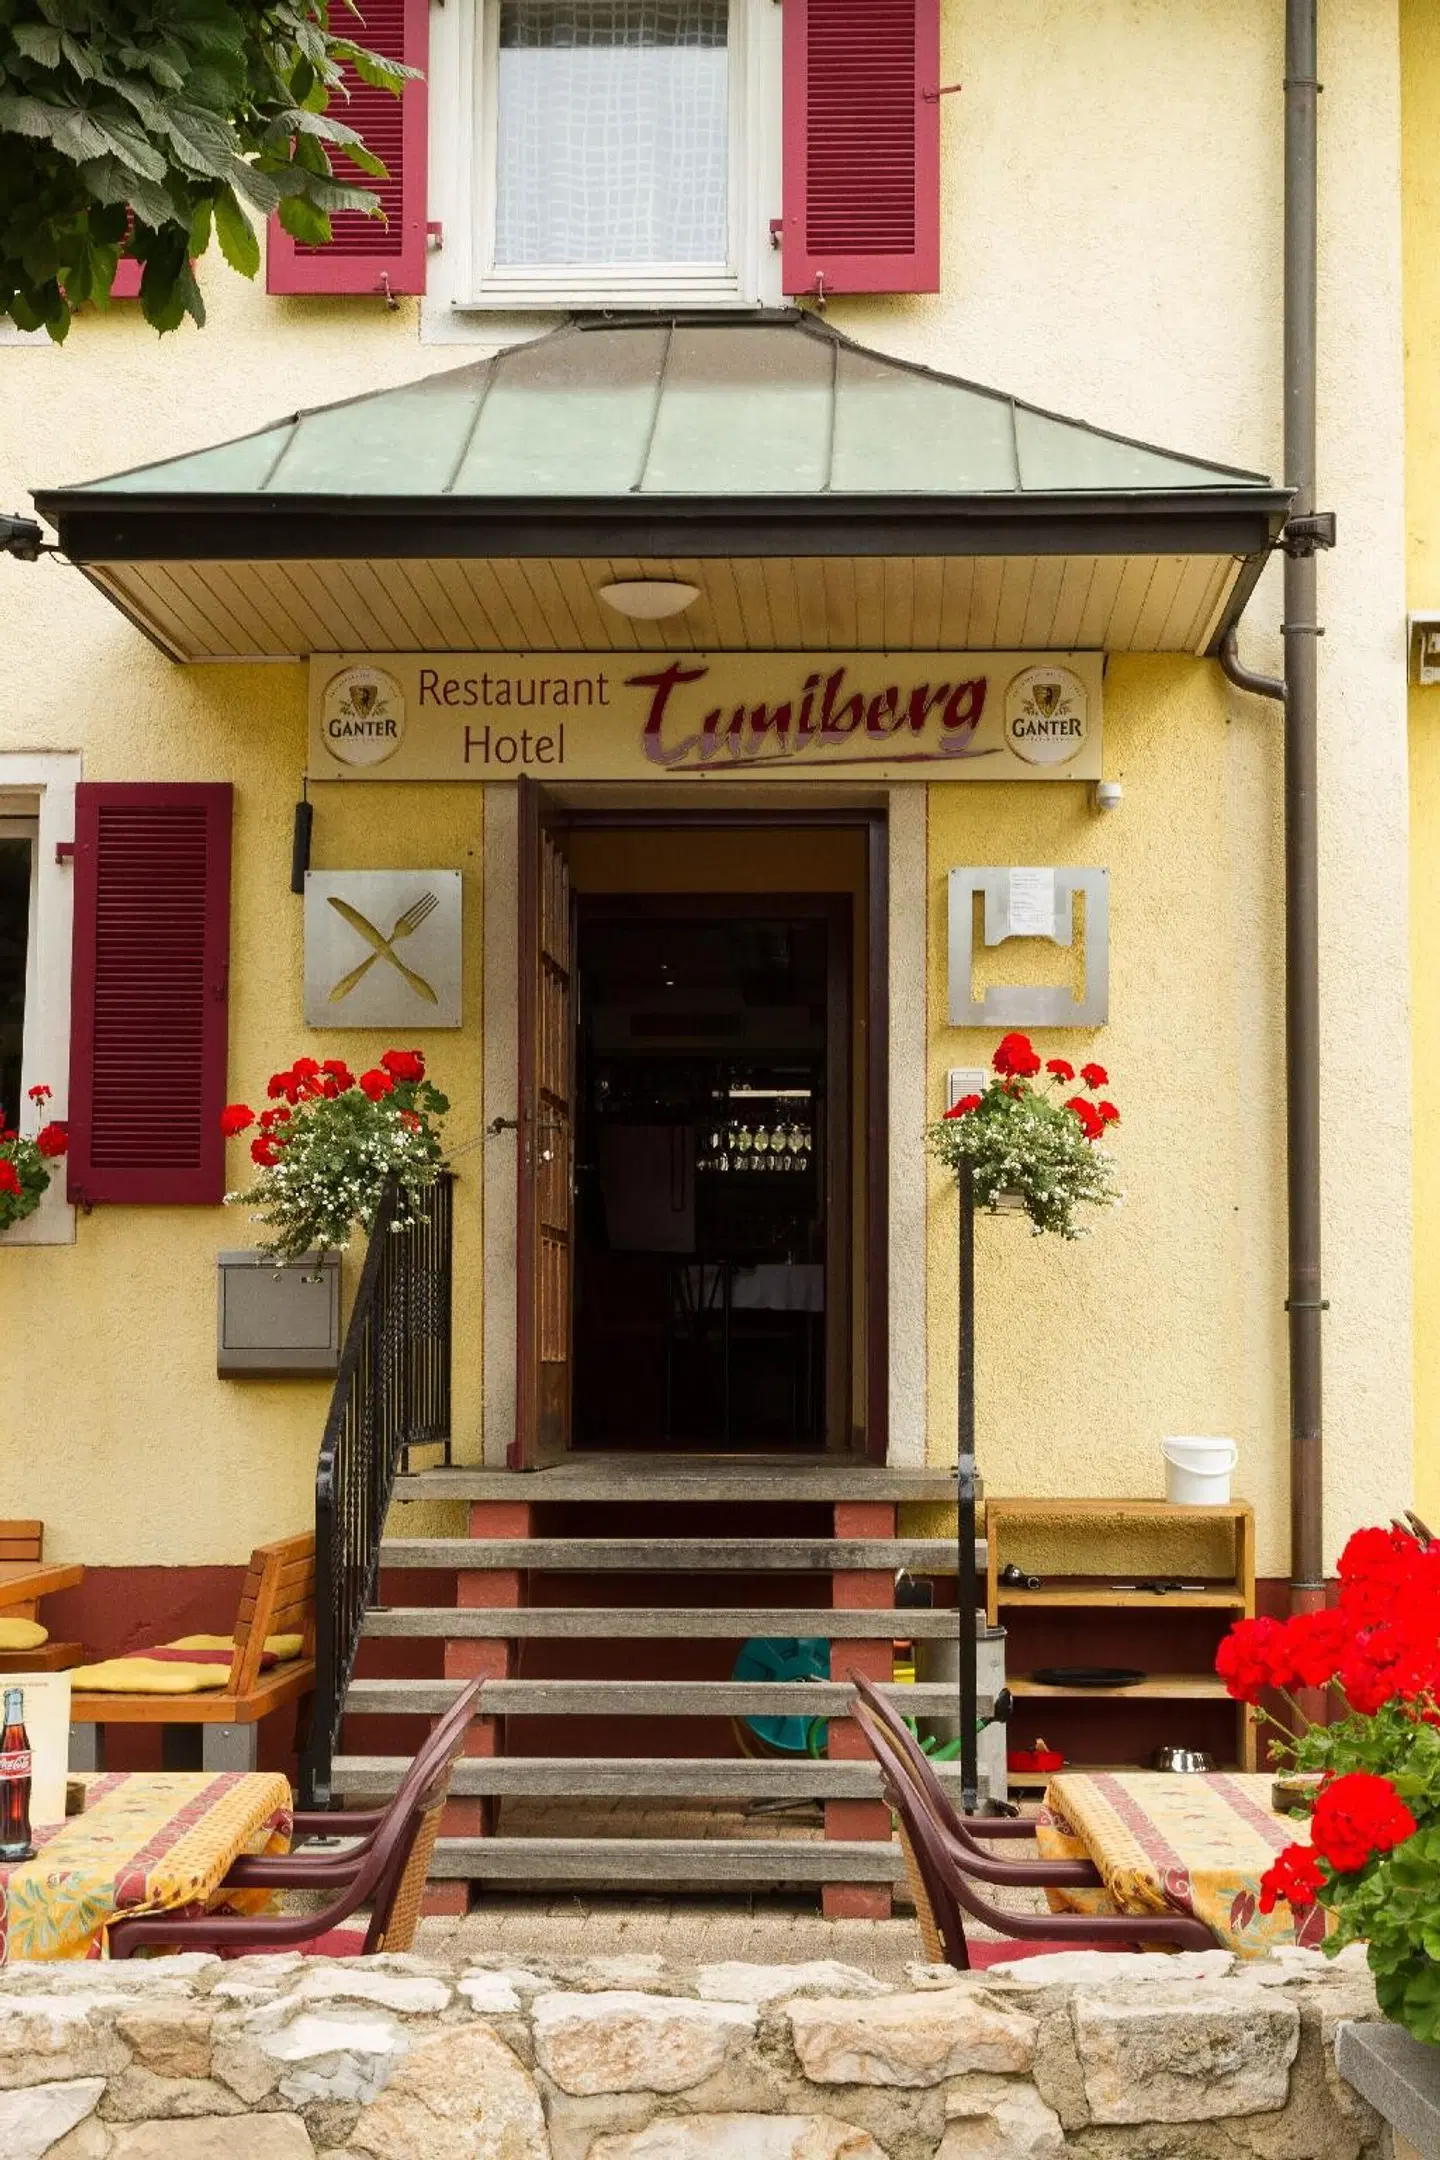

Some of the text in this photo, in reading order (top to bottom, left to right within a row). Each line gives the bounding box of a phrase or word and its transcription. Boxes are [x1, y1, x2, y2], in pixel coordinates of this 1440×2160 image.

[418, 669, 610, 706] Restaurant
[328, 718, 398, 739] GANTER
[623, 660, 989, 765] Tuniberg
[1012, 718, 1082, 738] GANTER
[463, 723, 565, 764] Hotel
